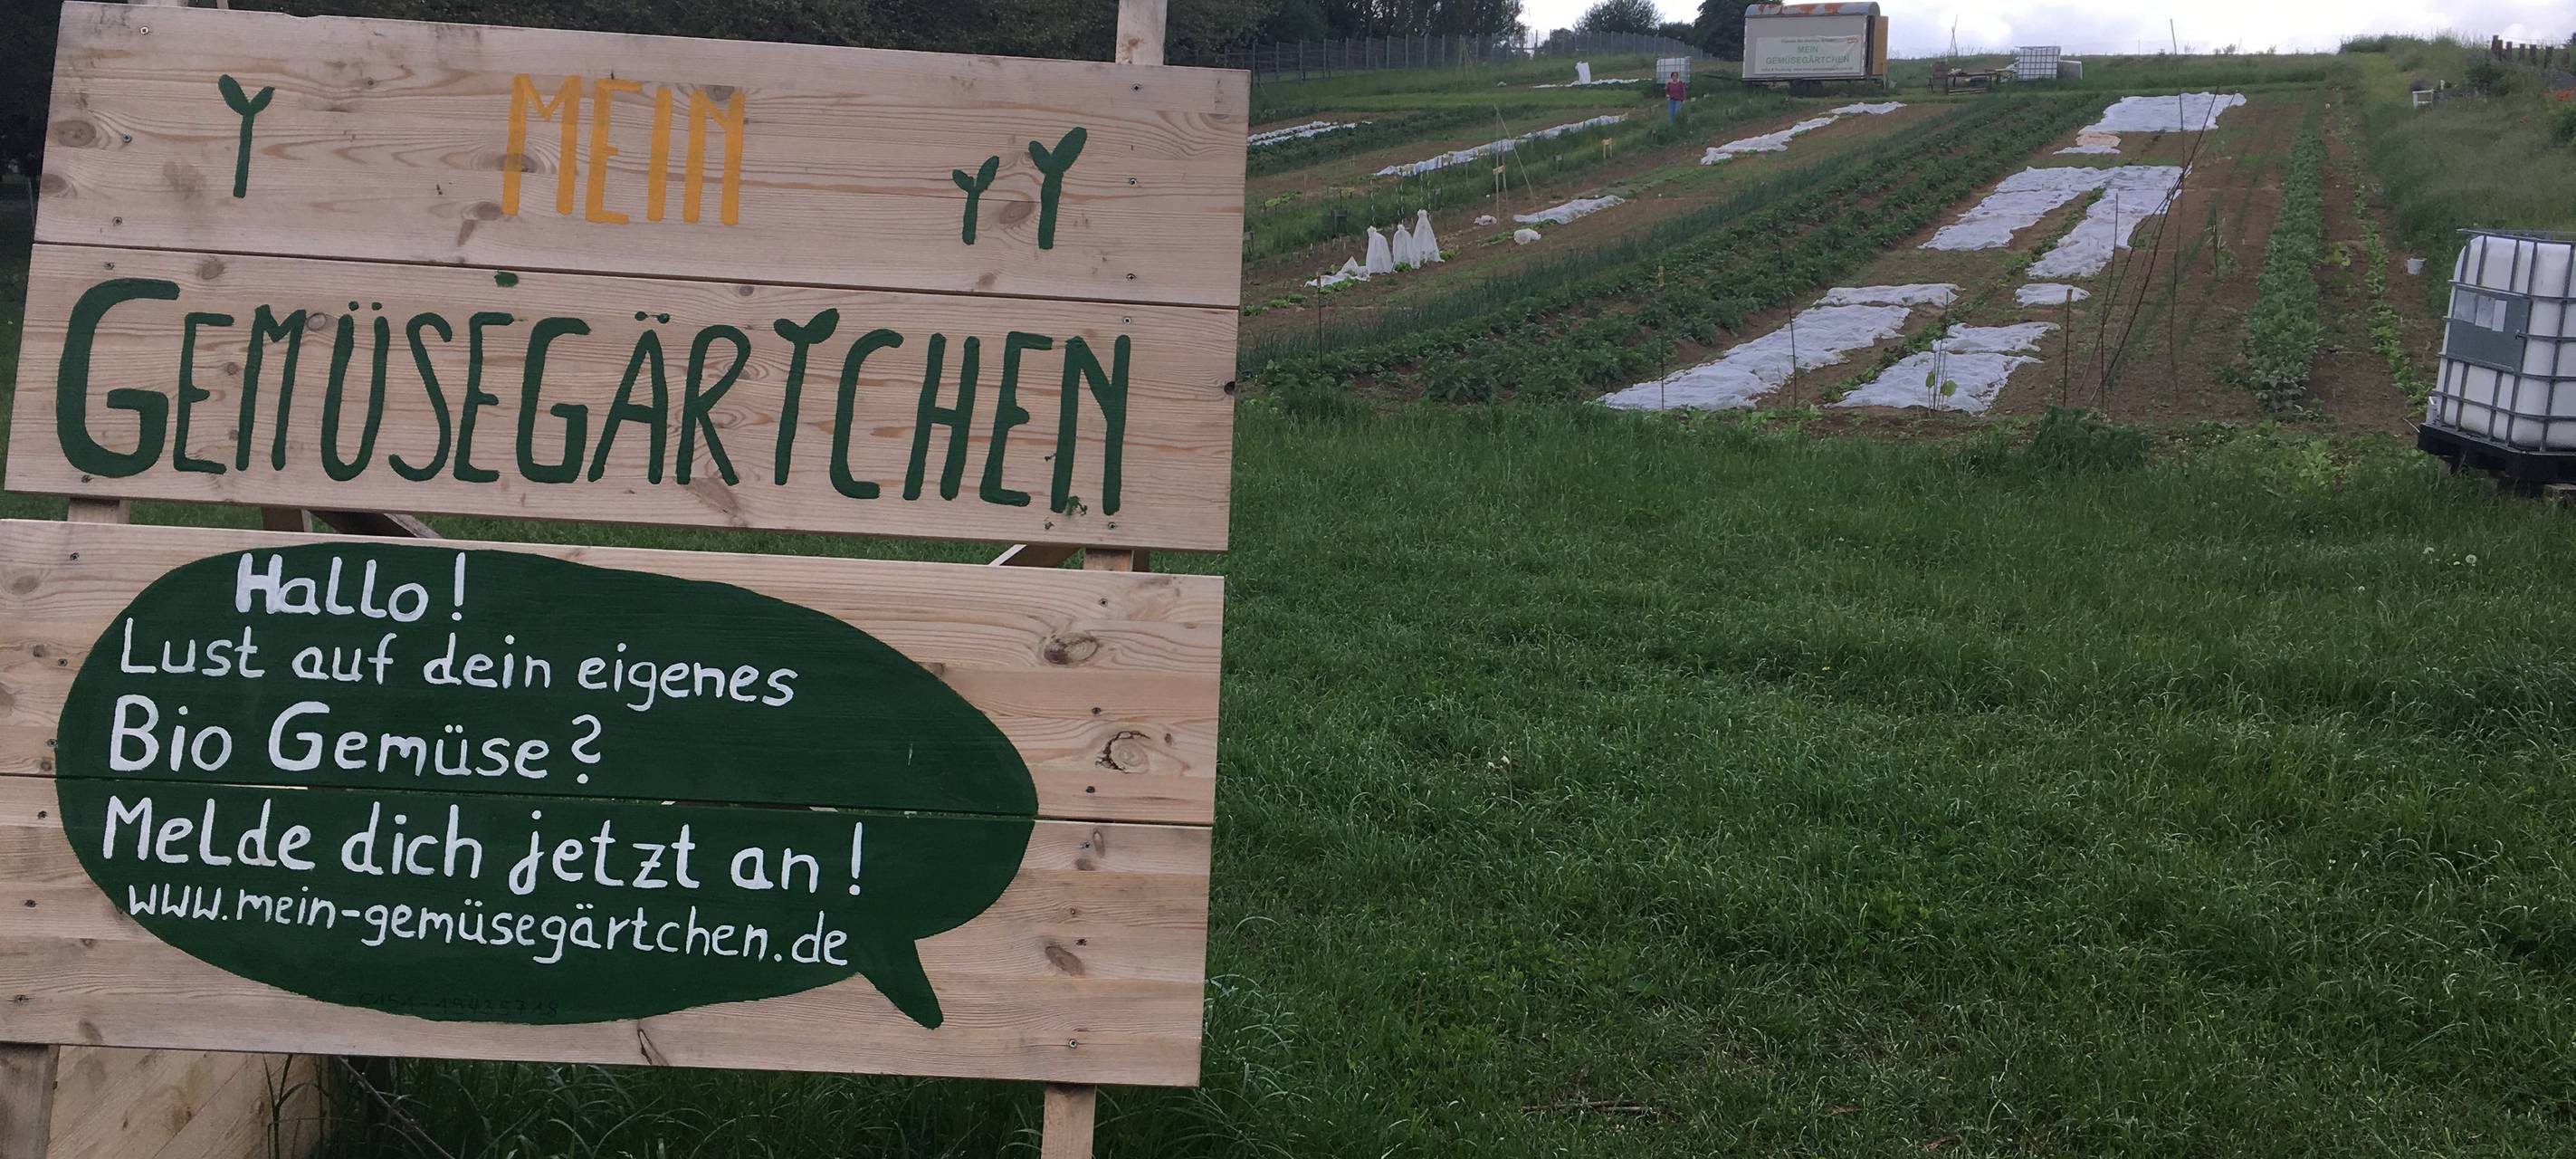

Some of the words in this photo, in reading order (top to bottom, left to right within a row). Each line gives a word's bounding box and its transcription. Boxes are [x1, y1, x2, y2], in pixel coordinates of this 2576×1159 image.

[1797, 45, 1818, 54] MEIN
[501, 74, 745, 225] MEIN
[120, 617, 266, 678] Lust
[291, 632, 397, 685] auf
[423, 632, 551, 689] dein
[577, 642, 798, 712] eigenes
[110, 694, 233, 772] Bio
[102, 795, 316, 870] Melde
[340, 800, 482, 879] dich
[508, 809, 701, 896] jetzt
[129, 882, 848, 966] www.mein-gemüsegärtchen.de
